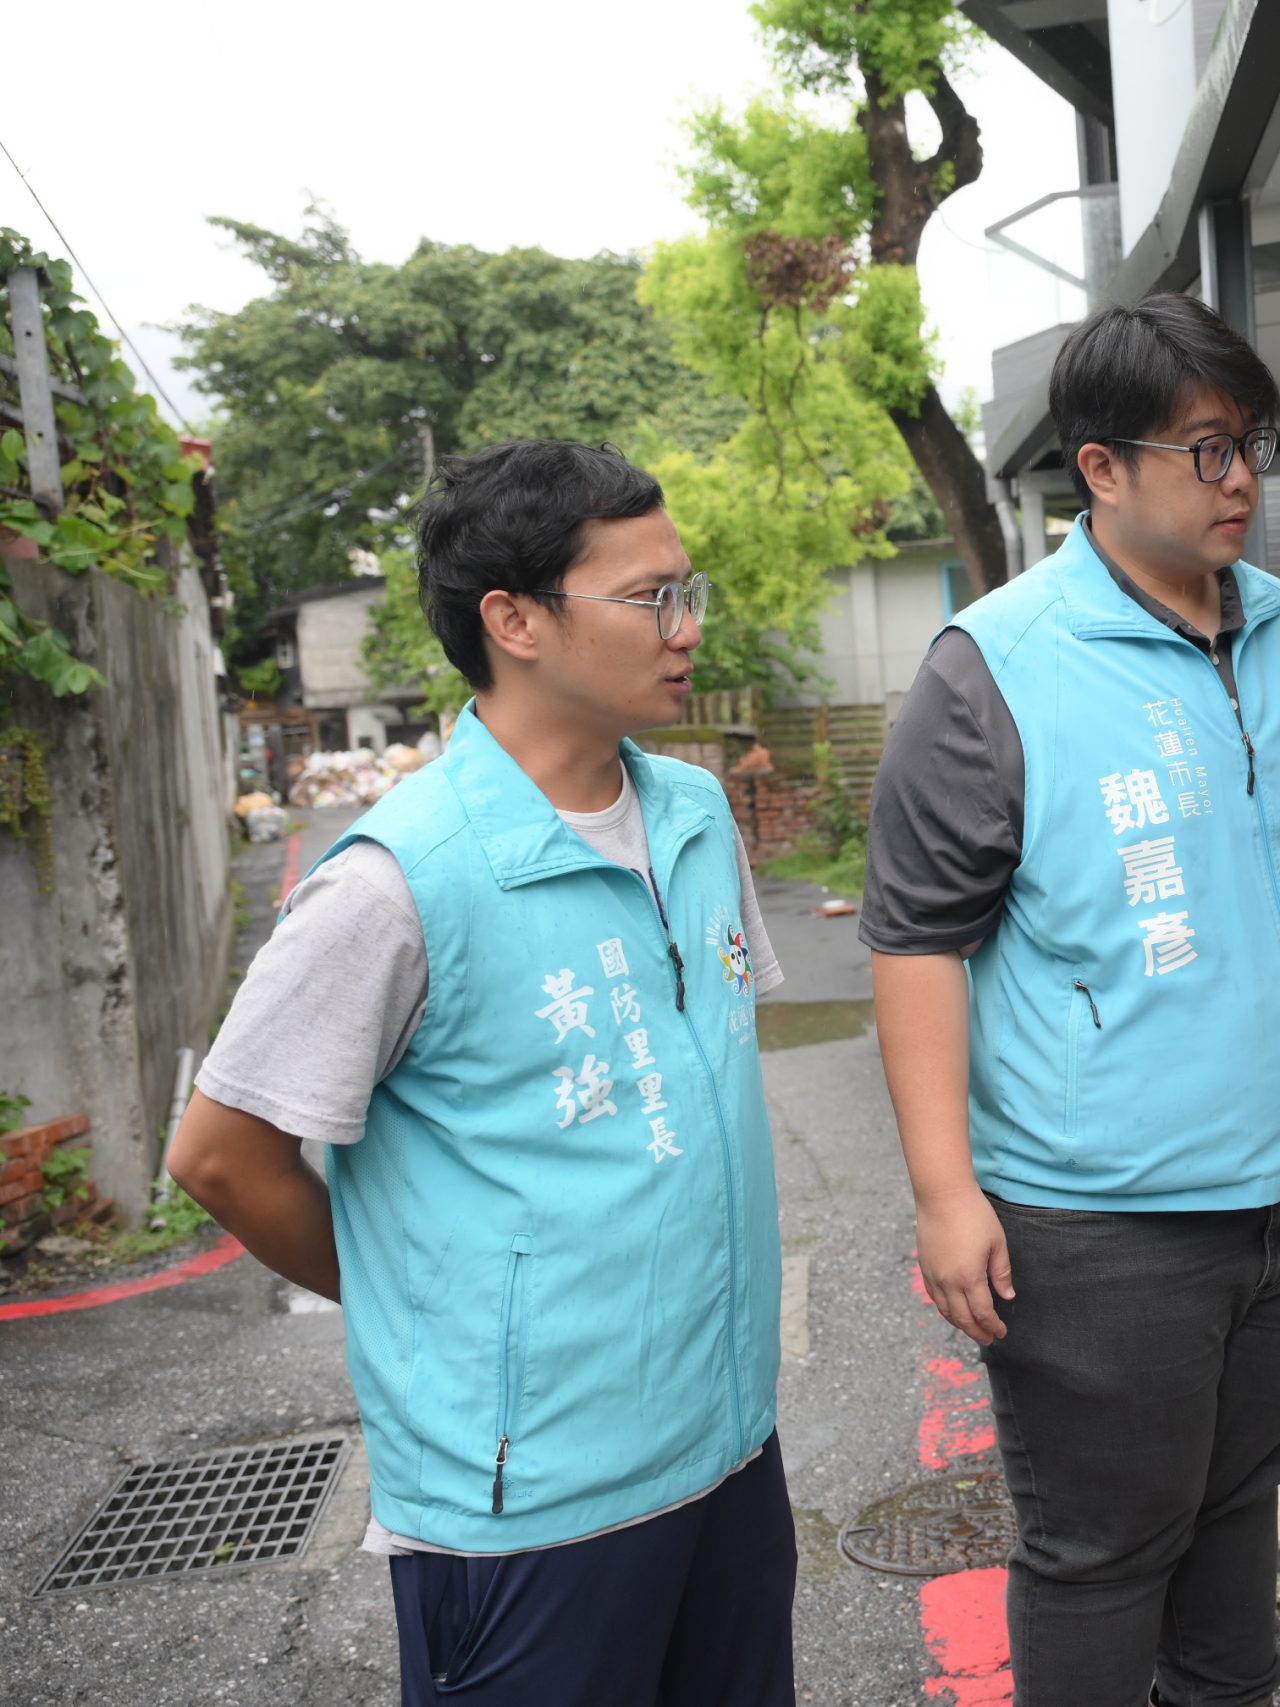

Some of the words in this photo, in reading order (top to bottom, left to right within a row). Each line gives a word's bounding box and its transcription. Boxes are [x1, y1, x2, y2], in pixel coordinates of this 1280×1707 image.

[1142, 699, 1203, 819] 花蓮市長
[1169, 696, 1199, 757] Hualien
[1194, 766, 1215, 815] Mayor
[1098, 767, 1200, 977] 魏嘉彥
[534, 967, 618, 1130] 黃強
[596, 937, 684, 1163] 國防里里長
